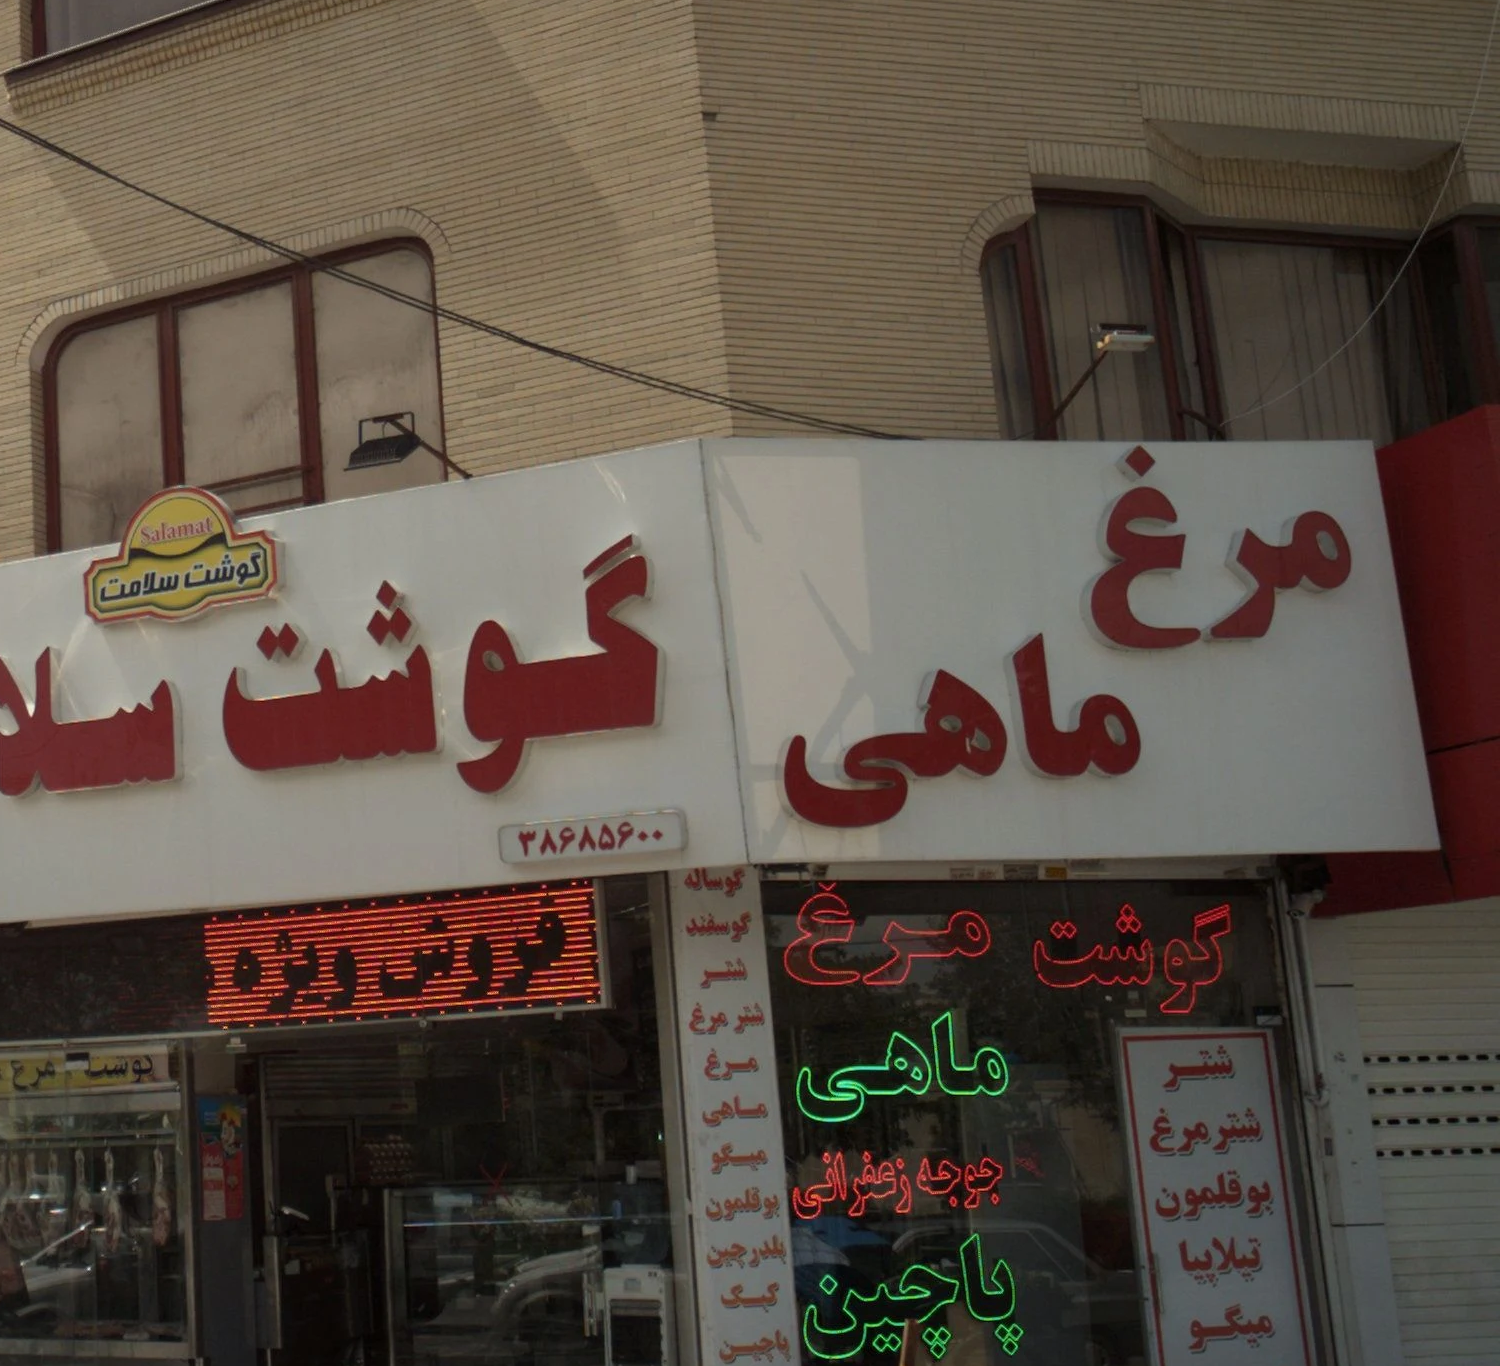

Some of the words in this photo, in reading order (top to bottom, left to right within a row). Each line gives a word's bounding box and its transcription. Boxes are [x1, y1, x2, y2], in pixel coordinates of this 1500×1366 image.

[141, 517, 214, 544] Salamat
[1092, 446, 1351, 649] مرغ
[100, 571, 180, 602] سلامت
[183, 551, 261, 588] گوشت
[222, 533, 660, 795] گوشت
[784, 633, 1142, 828] ماهی
[517, 821, 664, 857] ۳۸۶۸۵۶۰۰
[684, 866, 746, 896] گوساله
[685, 910, 751, 942] گوسفند
[783, 881, 992, 987] مرغ
[378, 893, 566, 999] فروش
[1033, 902, 1231, 1014] گوشت
[233, 932, 356, 1016] ویژه
[701, 957, 749, 989] شتر
[687, 1002, 729, 1034] مرغ
[734, 1003, 766, 1033] شتر
[704, 1048, 759, 1080] مرغ
[795, 1010, 1010, 1124] ماهی
[1163, 1044, 1234, 1090] شتر
[703, 1095, 767, 1127] ماهی
[712, 1143, 768, 1175] میگو
[791, 1150, 913, 1220] زعفرانی
[915, 1156, 1005, 1210] جوجه
[1155, 1170, 1273, 1220] بوقلمون
[706, 1188, 780, 1221] بوقلمون
[707, 1235, 787, 1268] بلدرچین
[1178, 1237, 1263, 1283] تیلاپیا
[721, 1282, 779, 1313] کبک
[802, 1233, 1026, 1361] پاچین
[1189, 1303, 1273, 1351] میگو
[719, 1329, 791, 1363] پاچین
